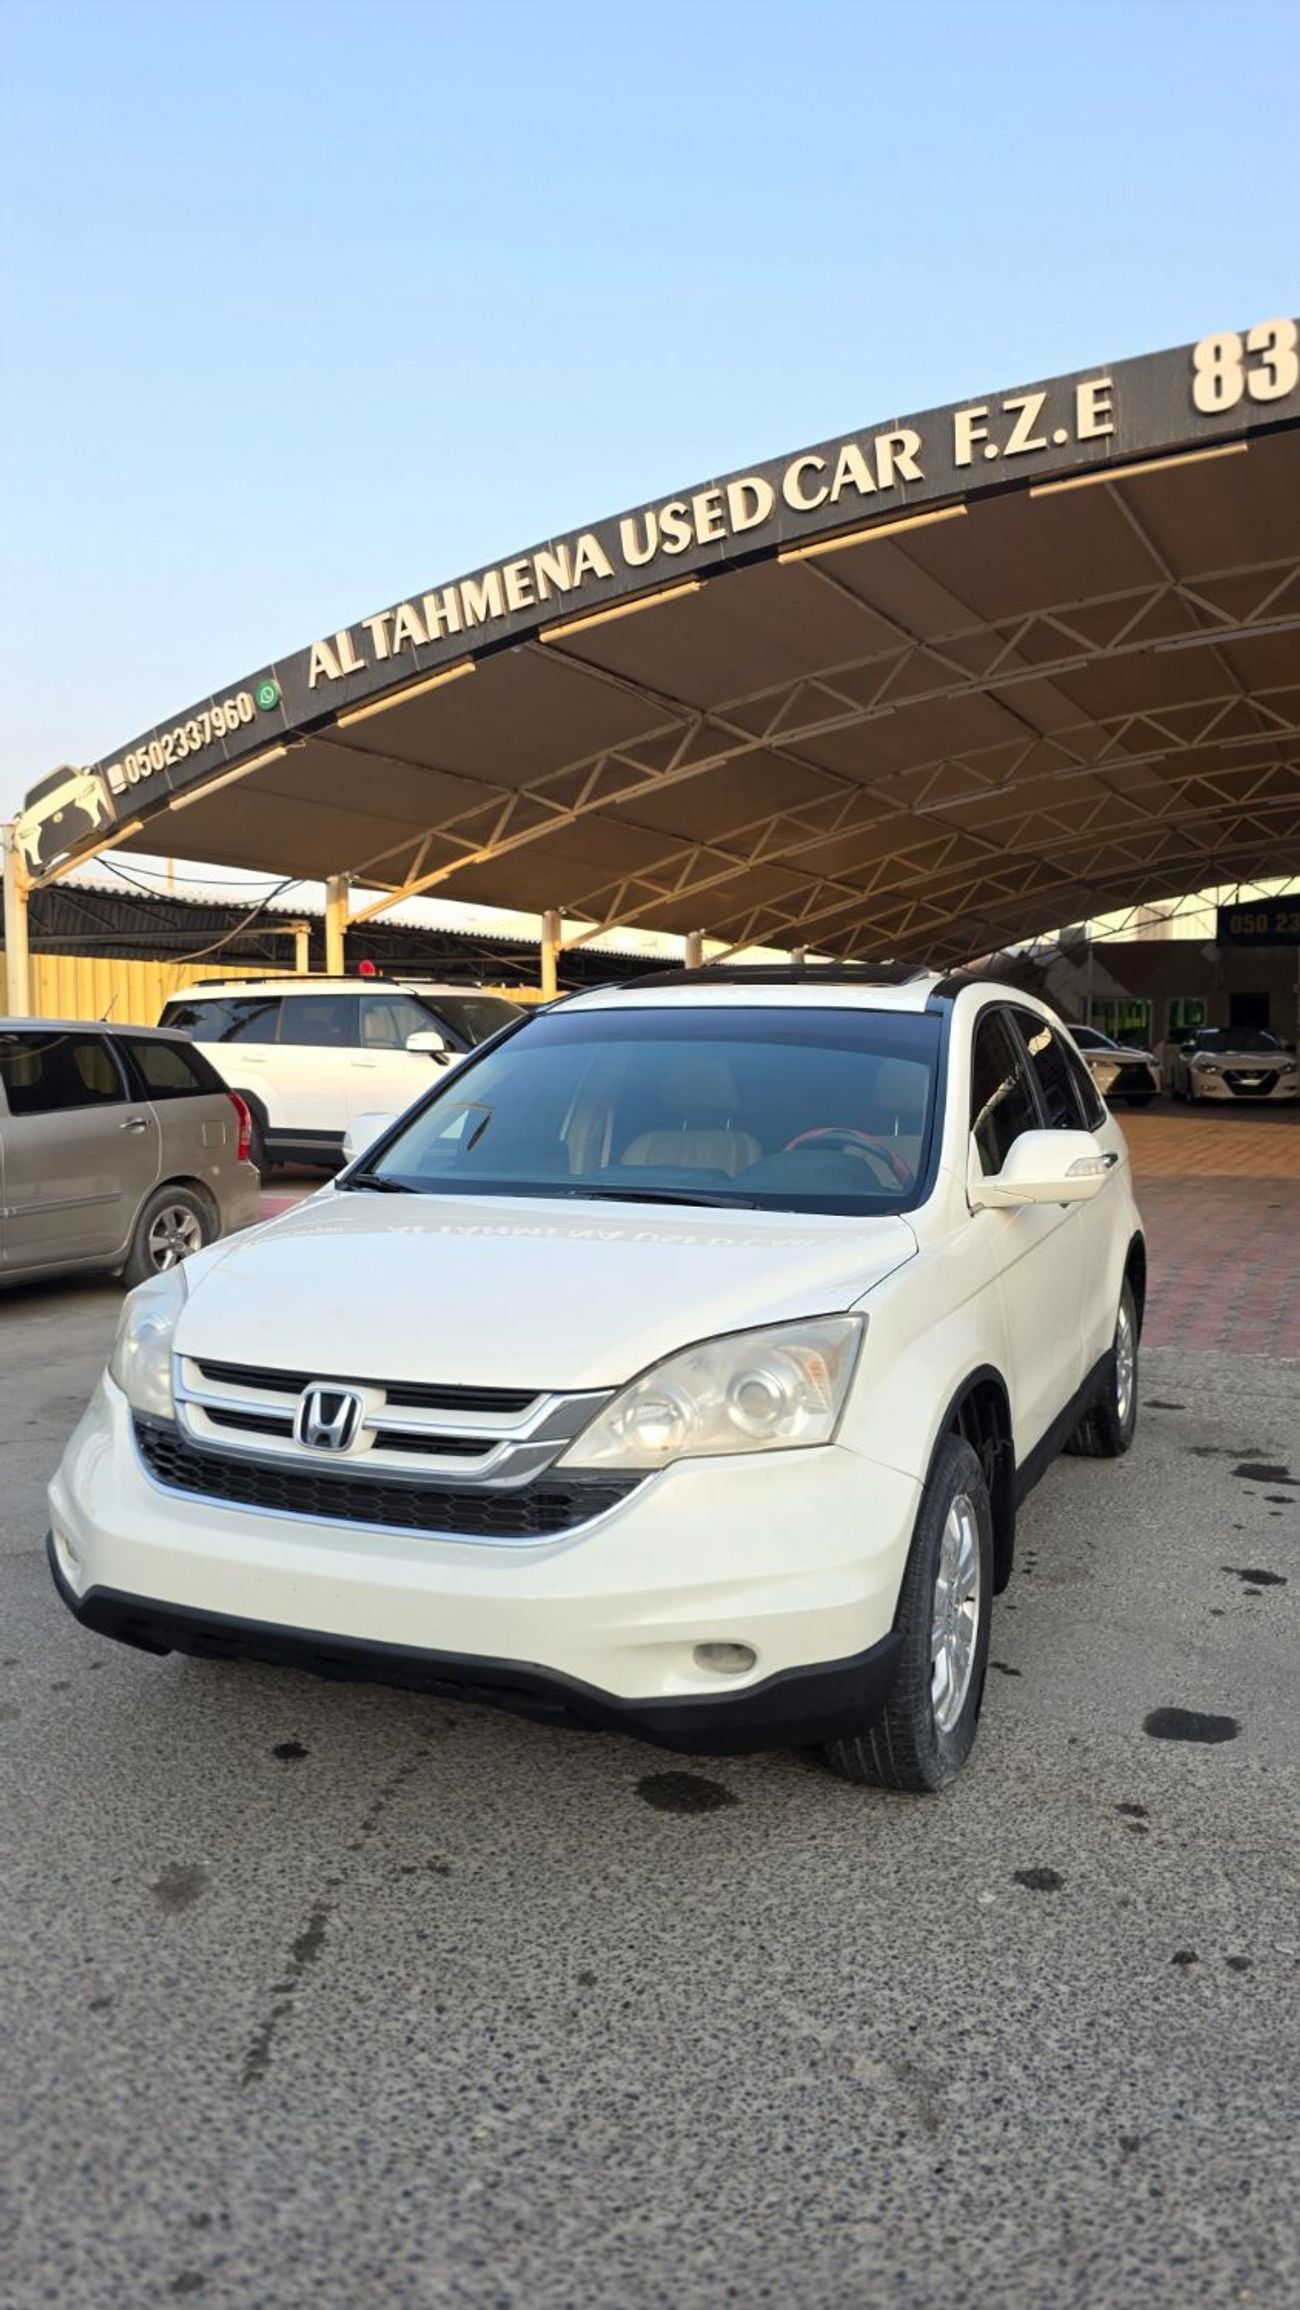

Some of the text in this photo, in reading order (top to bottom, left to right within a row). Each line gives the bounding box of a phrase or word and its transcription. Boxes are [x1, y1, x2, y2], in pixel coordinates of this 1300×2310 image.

[1192, 317, 1300, 413] 83
[620, 477, 774, 567] USED
[782, 429, 925, 511] CAR
[124, 692, 255, 784] 0502337960
[1231, 914, 1268, 934] 050
